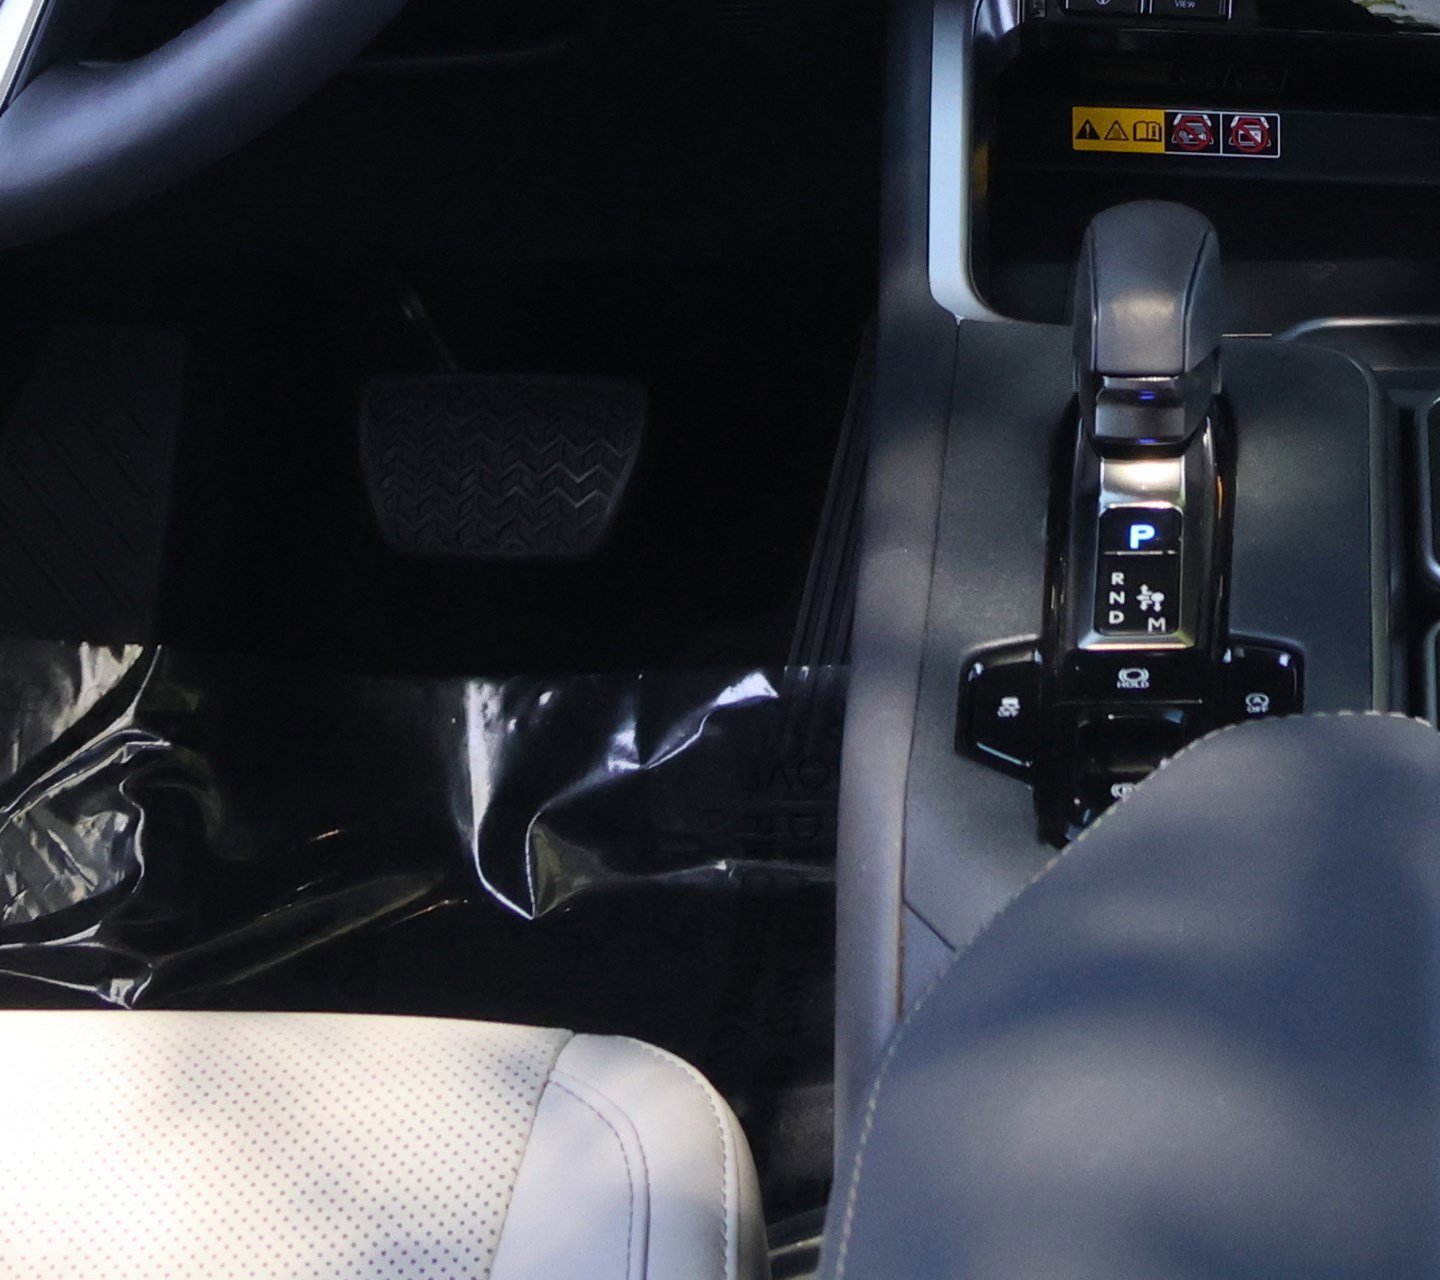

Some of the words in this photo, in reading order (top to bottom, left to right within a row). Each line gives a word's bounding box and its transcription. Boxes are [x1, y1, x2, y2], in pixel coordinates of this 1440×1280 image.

[1174, 0, 1196, 9] VIEW
[1129, 524, 1155, 549] P
[1111, 572, 1124, 586] R
[1109, 590, 1125, 605] N
[1108, 610, 1124, 624] D
[1148, 617, 1166, 633] M
